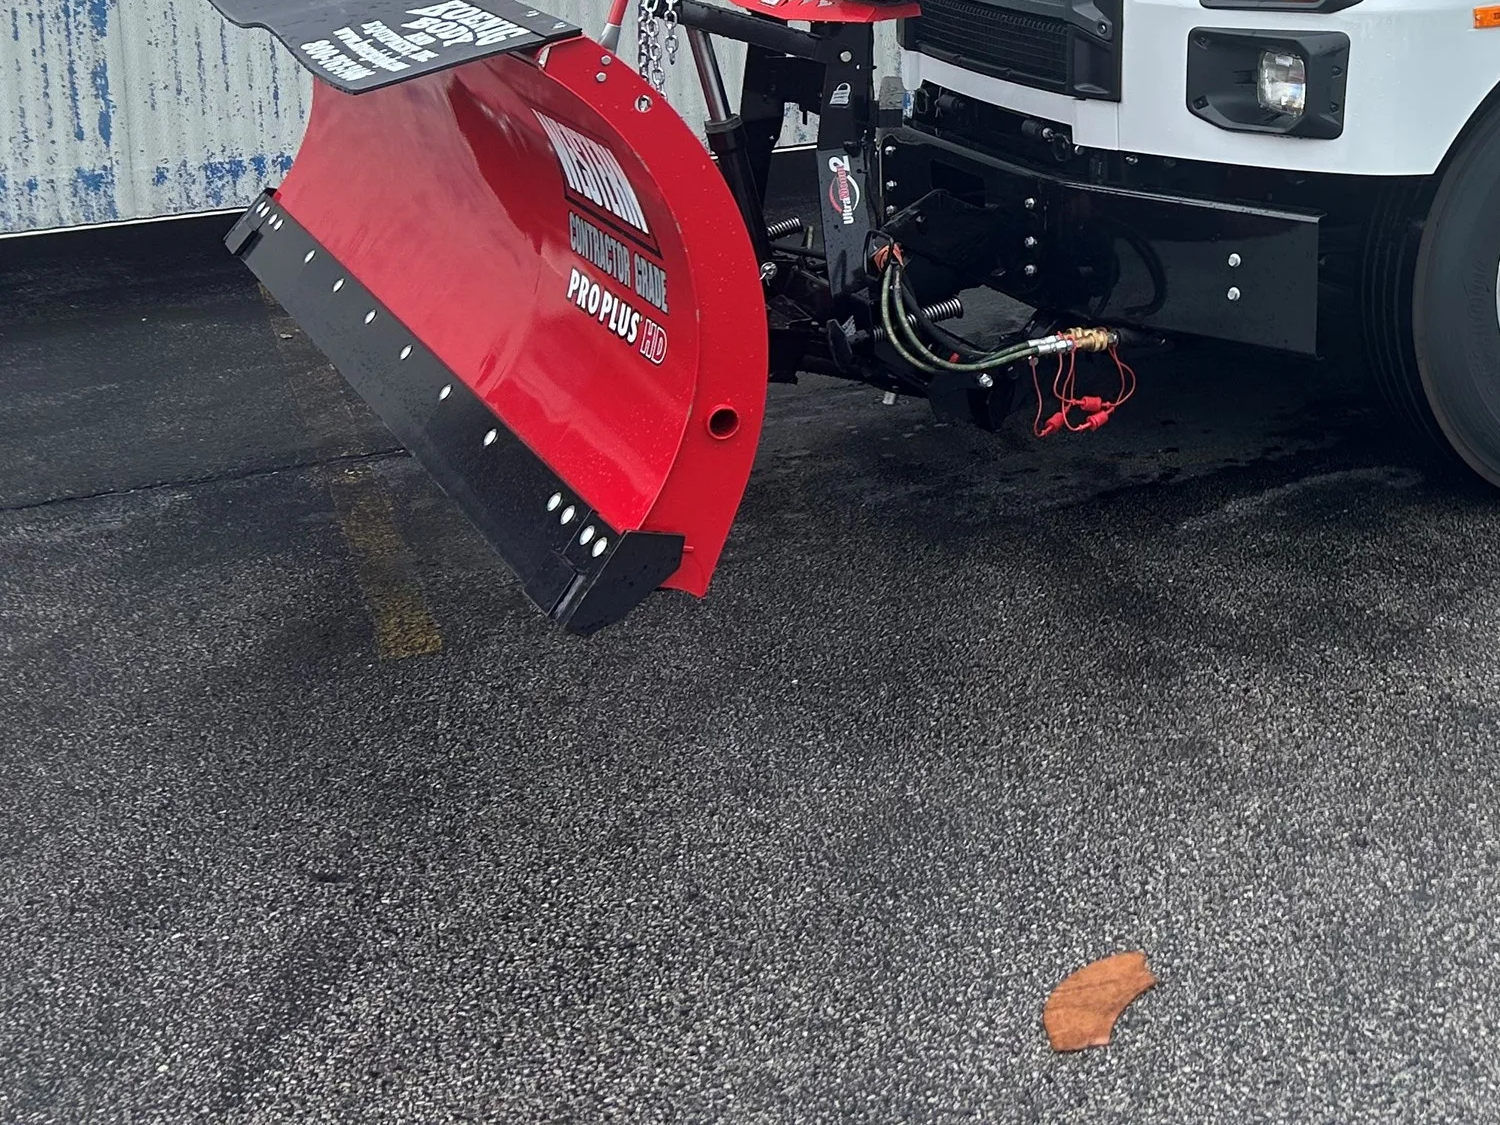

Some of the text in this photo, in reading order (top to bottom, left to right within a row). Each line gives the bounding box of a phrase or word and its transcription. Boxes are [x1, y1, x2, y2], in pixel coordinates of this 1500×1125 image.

[400, 17, 474, 47] BODY
[404, 0, 532, 47] KOENIG
[531, 107, 650, 235] WESTERN
[568, 210, 669, 313] CONTRACTOR GRADE
[640, 318, 668, 365] HD
